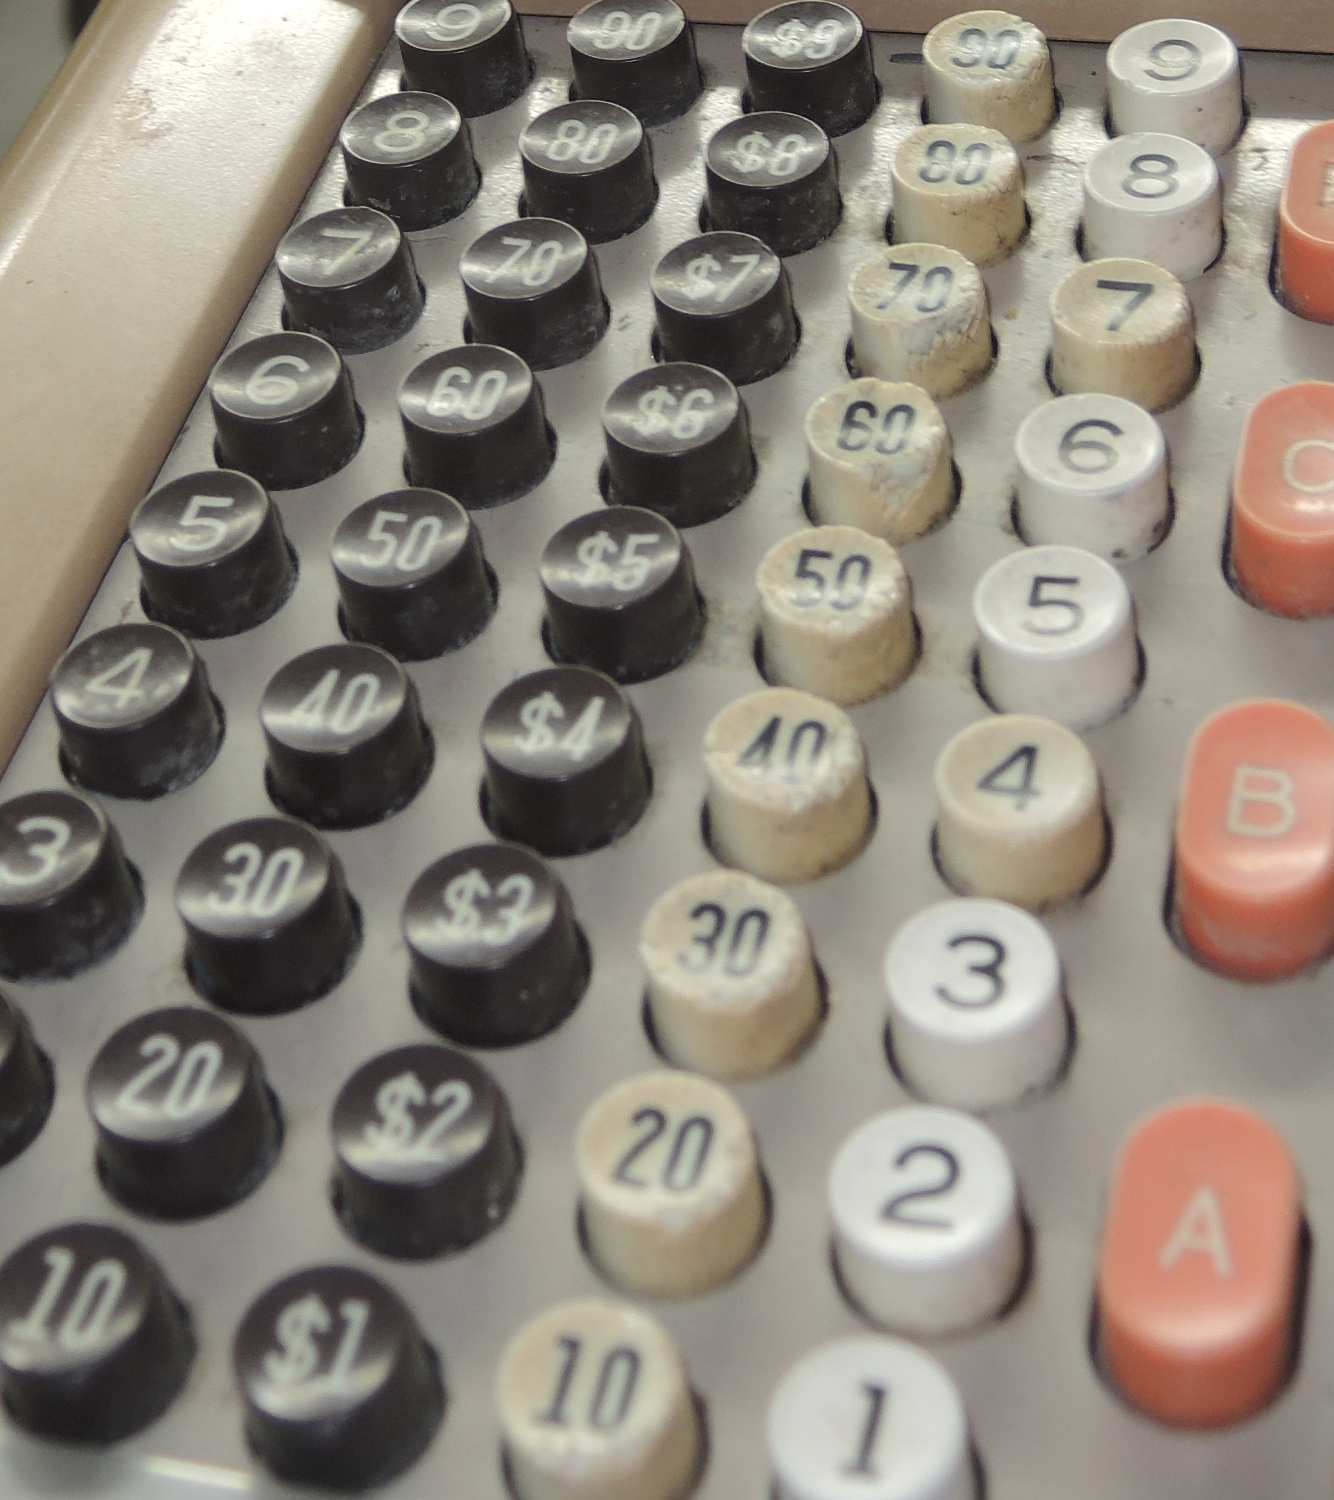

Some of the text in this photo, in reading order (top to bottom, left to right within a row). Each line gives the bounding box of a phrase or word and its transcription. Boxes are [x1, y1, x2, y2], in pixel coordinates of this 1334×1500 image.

[428, 3, 480, 41] 9
[592, 10, 662, 50] 90
[770, 18, 841, 59] $9
[951, 28, 1021, 70] 90
[1144, 39, 1201, 81] 9
[374, 110, 430, 153] 8
[547, 120, 618, 164] 80
[736, 132, 807, 176] $8
[918, 140, 992, 185] 80
[1122, 153, 1178, 197] 8
[322, 229, 372, 275] 7
[485, 237, 564, 287] 70
[685, 253, 759, 301] $7
[875, 262, 953, 312] 70
[1096, 280, 1154, 330] 7
[245, 354, 310, 404] 6
[426, 367, 507, 421] 60
[637, 386, 714, 438] $6
[837, 401, 915, 454] 60
[1058, 419, 1124, 472] 6
[168, 495, 234, 550] 5
[363, 510, 445, 572] 50
[575, 531, 658, 591] $5
[790, 549, 873, 610] 50
[1022, 576, 1083, 635] 5
[86, 647, 153, 708] 4
[294, 669, 381, 733] 40
[514, 692, 603, 759] $4
[739, 717, 826, 779] 40
[977, 745, 1042, 811] 4
[1227, 765, 1297, 836] B
[207, 843, 304, 917] 30
[433, 869, 533, 944] $3
[677, 902, 770, 977] 30
[935, 935, 1006, 1008] 3
[117, 1033, 223, 1119] 20
[365, 1072, 472, 1155] $2
[612, 1108, 714, 1193] 20
[880, 1144, 960, 1230] 2
[1157, 1185, 1233, 1277] A
[9, 1247, 127, 1347] 10
[269, 1293, 369, 1392] $1
[536, 1331, 640, 1432] 10
[840, 1381, 888, 1479] 1
